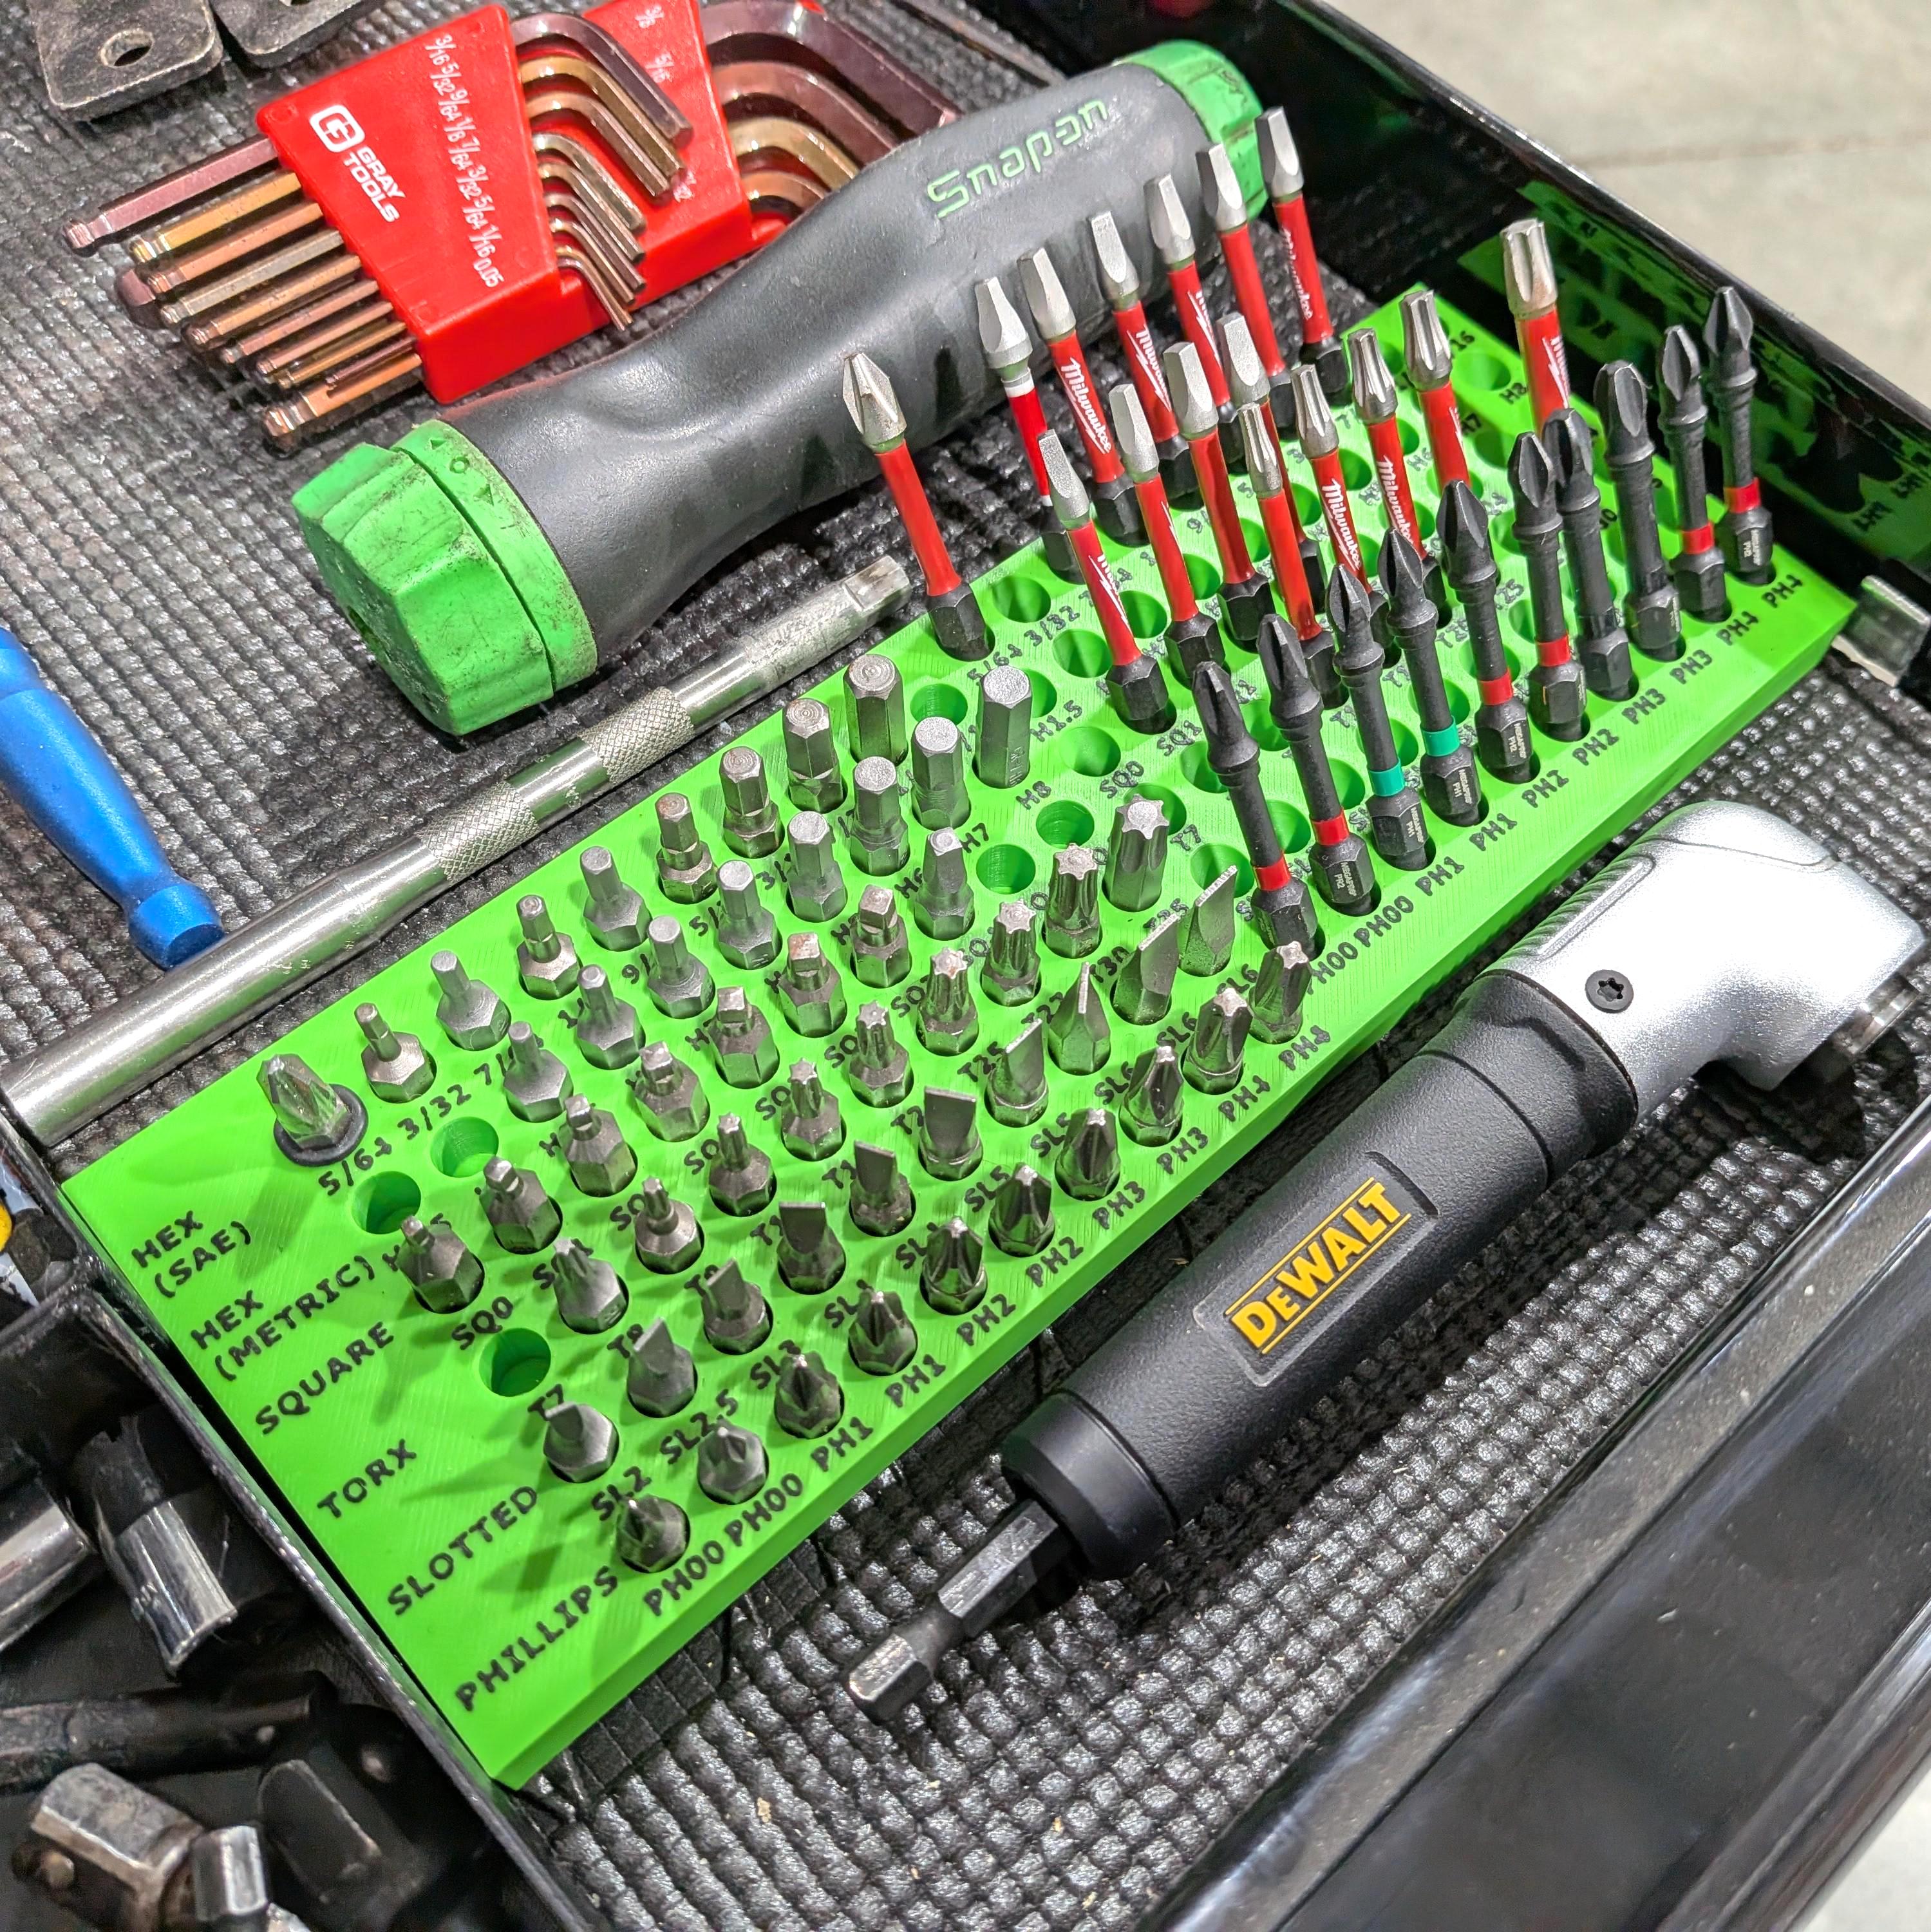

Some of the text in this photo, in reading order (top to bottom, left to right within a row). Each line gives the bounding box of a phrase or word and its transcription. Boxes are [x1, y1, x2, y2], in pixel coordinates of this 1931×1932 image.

[343, 156, 400, 223] TOOLS
[359, 146, 406, 200] GRAY
[425, 33, 504, 287] 3/16 5/32 9/64 1/8 7/64 3/32 5/64 1/16 0.05
[1060, 357, 1112, 454] Milwaukee
[1322, 478, 1361, 571] Milwaukee
[1030, 699, 1083, 742] H1.5
[1099, 719, 1203, 799] SQ0 SQ1
[1453, 782, 1461, 798] PH1
[961, 822, 990, 854] H7
[1015, 780, 1052, 810] H8
[1170, 824, 1202, 851] T7
[1307, 942, 1359, 994] H00
[1353, 895, 1415, 946] PH00
[1417, 855, 1464, 895] PH1
[1469, 813, 1518, 851] PH1
[1521, 770, 1570, 808] PH2
[1572, 728, 1620, 766] PH2
[1621, 688, 1666, 725] PH3
[1669, 649, 1713, 685] PH3
[1335, 874, 1344, 889] PR2
[399, 1085, 469, 1139] 3/32
[133, 1211, 203, 1267] HEX
[155, 1221, 252, 1298] (SAE)
[191, 1291, 262, 1349] HEX
[216, 1256, 375, 1381] (METRIC)
[449, 1296, 514, 1350] SQ0
[256, 1323, 393, 1433] SQUARE
[528, 1384, 564, 1421] T7
[643, 1541, 725, 1615] PH00
[725, 1473, 804, 1546] PH00
[811, 1417, 873, 1472] PH1
[886, 1354, 947, 1408] PH1
[957, 1294, 1017, 1346] PH2
[1025, 1236, 1084, 1288] PH2
[1092, 1181, 1147, 1229] PH3
[1157, 1127, 1209, 1175] PH3
[659, 1388, 738, 1463] SL2.5
[319, 1441, 415, 1518] TORX
[388, 1486, 539, 1615] SLOTTED
[456, 1566, 619, 1711] PHILLIPS
